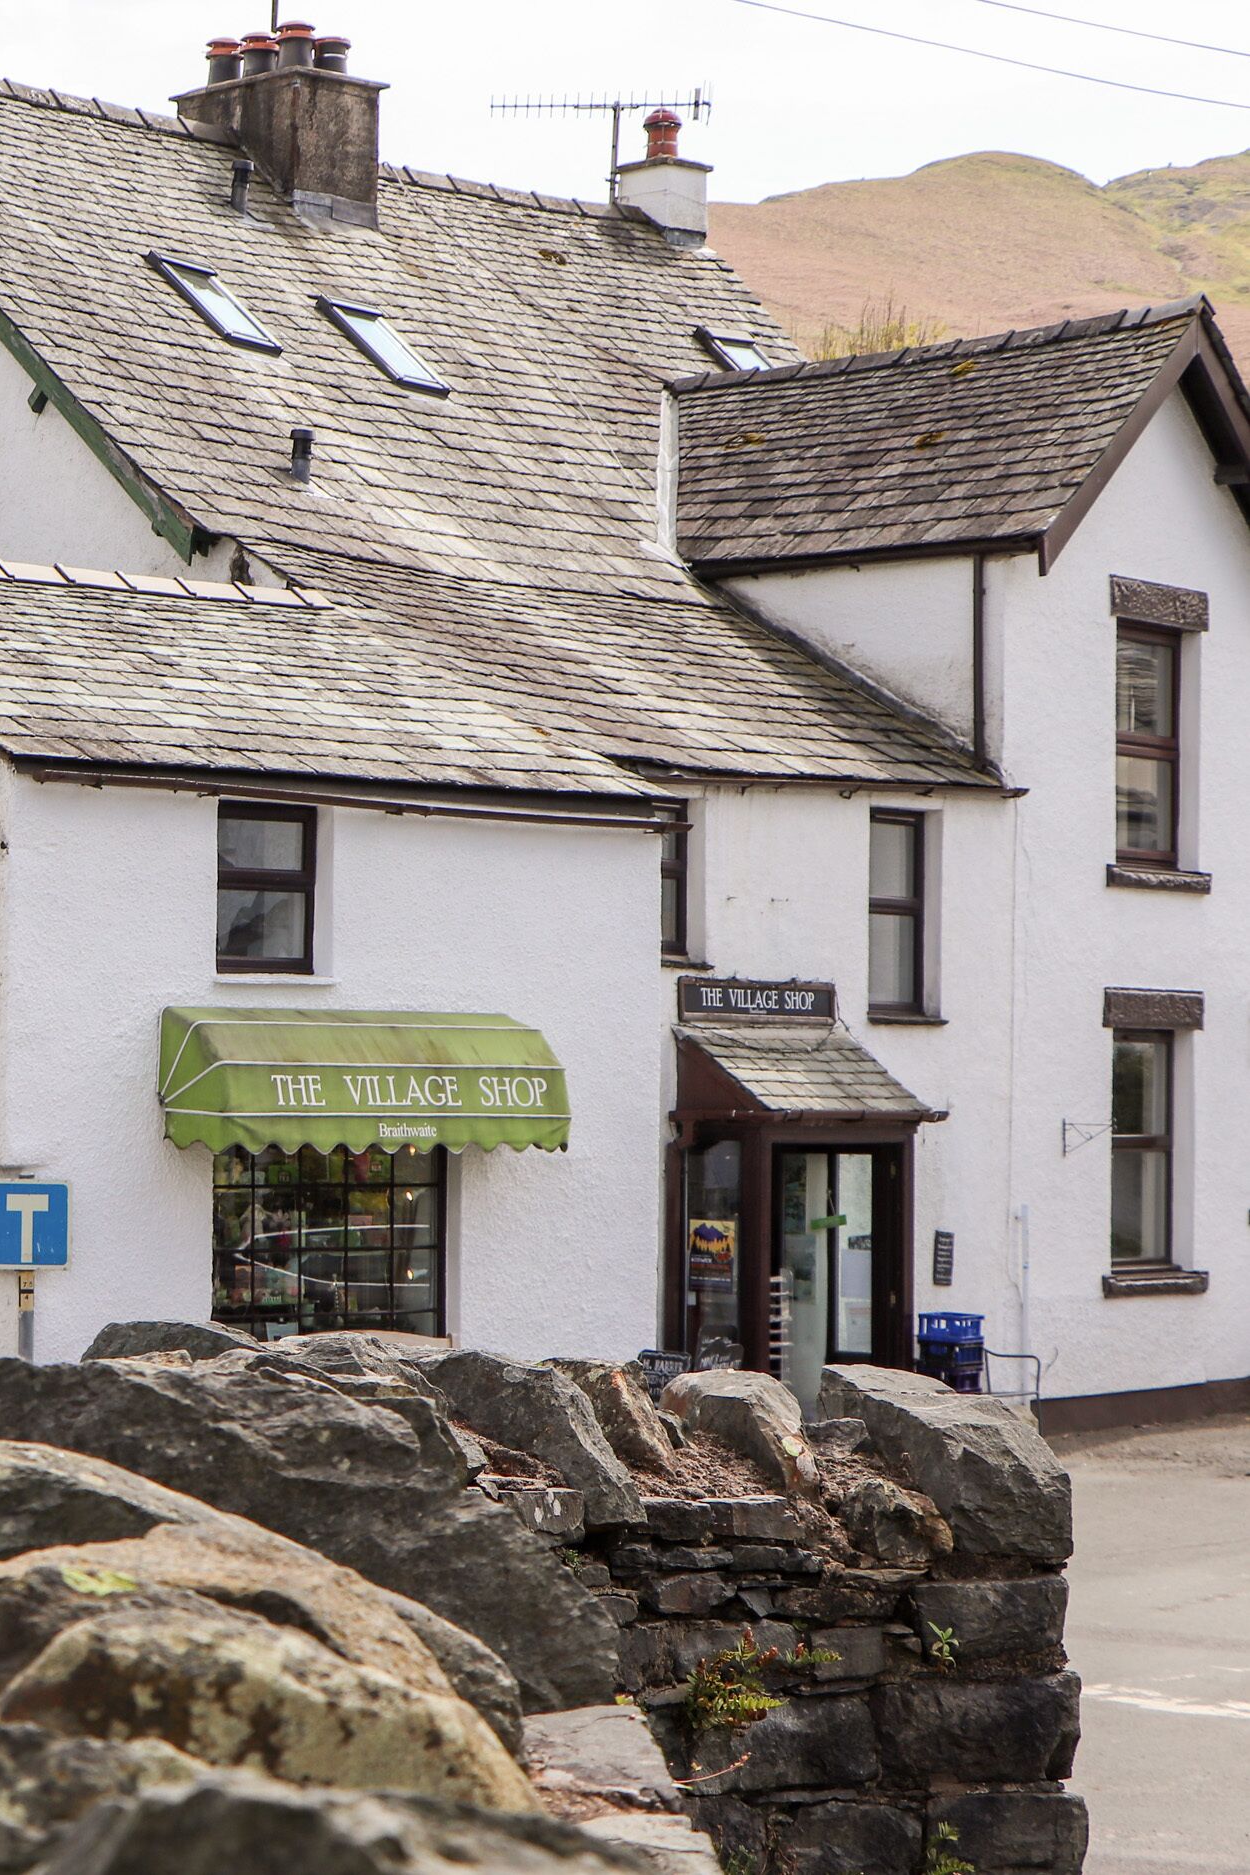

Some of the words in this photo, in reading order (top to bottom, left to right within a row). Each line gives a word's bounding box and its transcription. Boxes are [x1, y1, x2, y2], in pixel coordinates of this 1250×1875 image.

[700, 987, 724, 1008] THE
[728, 988, 780, 1010] VILLAGE
[784, 990, 815, 1010] SHOP
[270, 1074, 327, 1107] THE
[342, 1075, 463, 1107] VILLAGE
[478, 1076, 548, 1108] SHOP
[378, 1123, 438, 1138] Braithwaite
